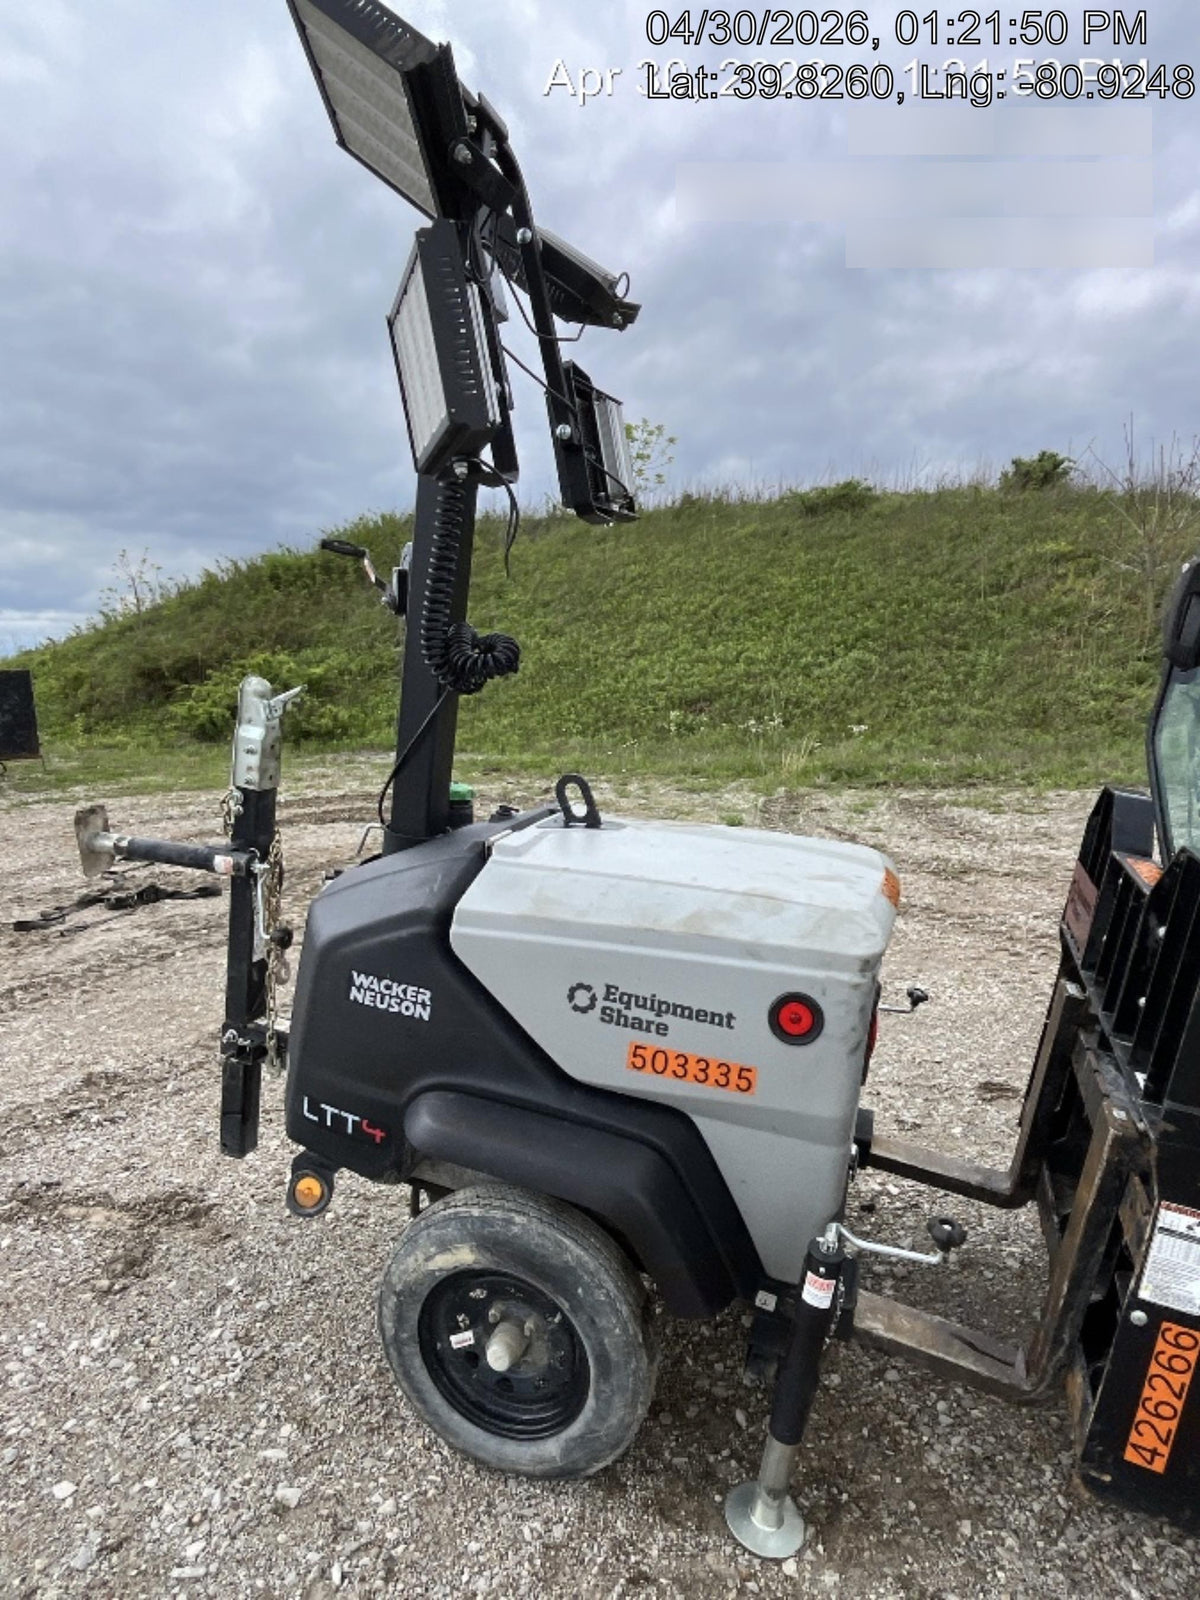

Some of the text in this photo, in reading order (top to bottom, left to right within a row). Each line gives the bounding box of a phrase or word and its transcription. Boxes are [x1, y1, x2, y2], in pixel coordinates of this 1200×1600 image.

[349, 986, 431, 1021] NEUSON
[351, 970, 432, 1005] WACKER
[600, 1005, 670, 1037] Share
[602, 986, 737, 1030] Equipment
[630, 1045, 753, 1093] 503335
[1129, 1327, 1199, 1466] 426266
